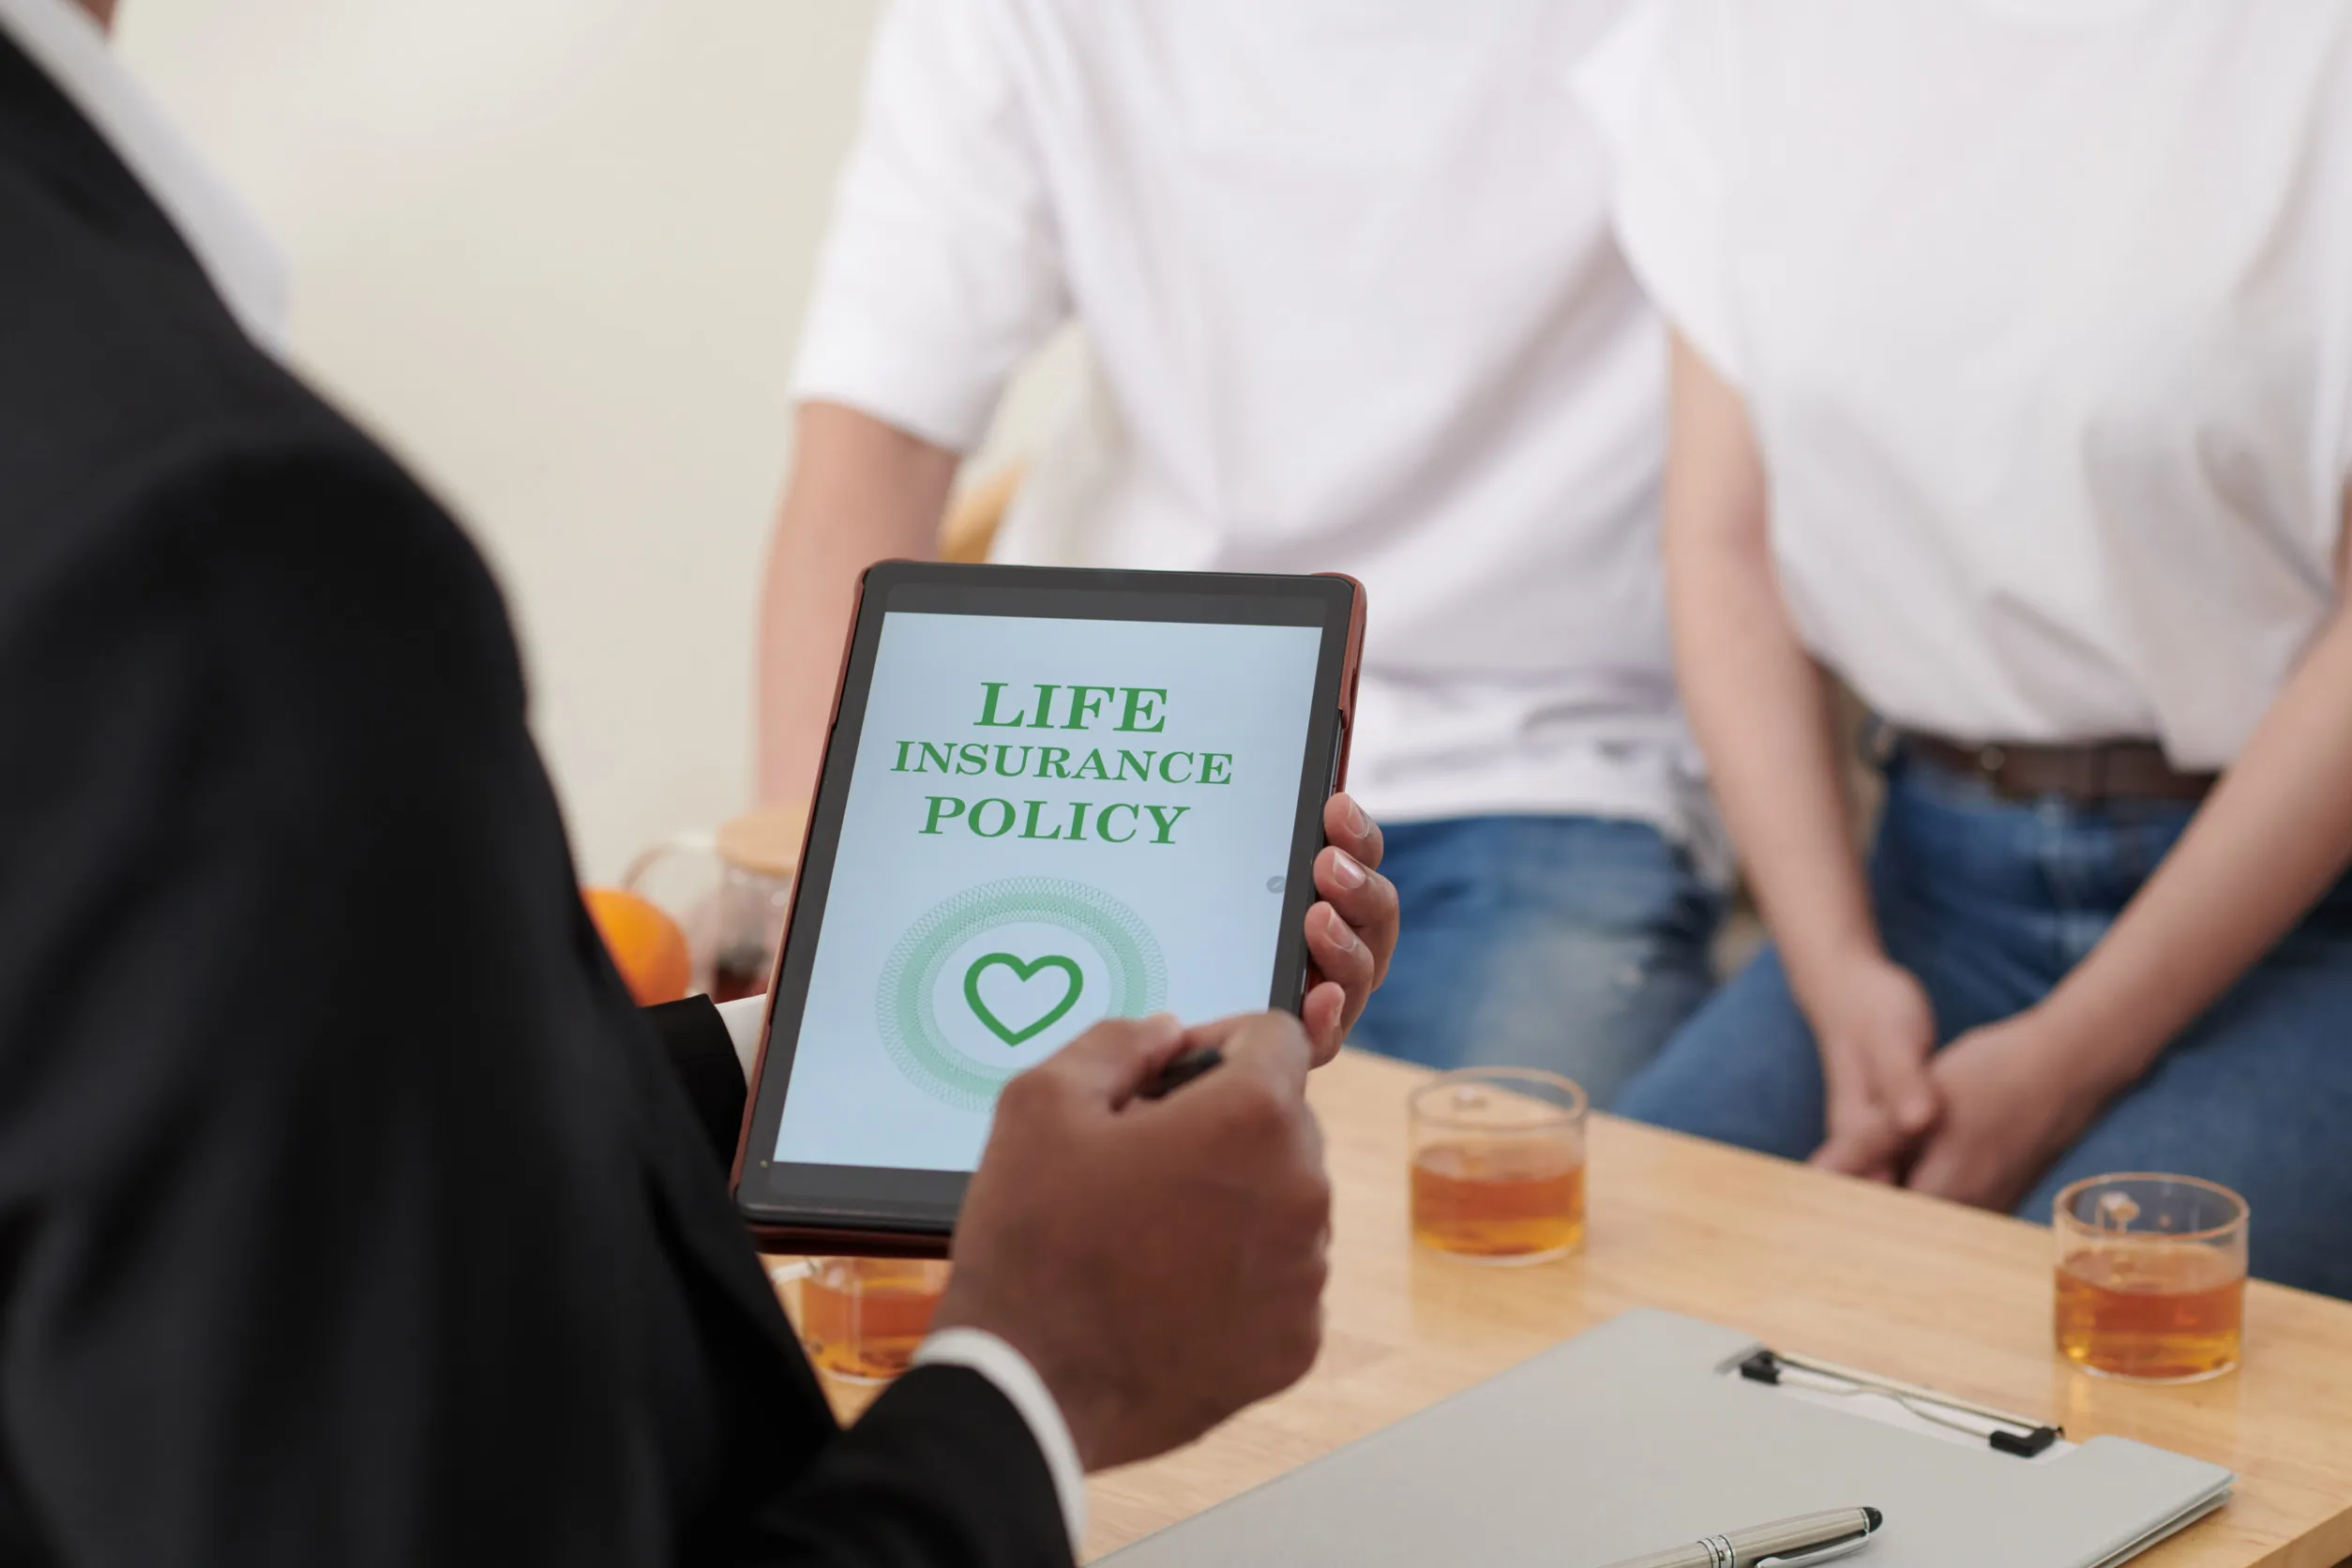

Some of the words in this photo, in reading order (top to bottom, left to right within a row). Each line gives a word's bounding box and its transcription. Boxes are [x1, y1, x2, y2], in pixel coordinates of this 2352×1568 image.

[973, 682, 1168, 732] LIFE
[890, 740, 1233, 785] INSURANCE
[918, 795, 1191, 845] POLICY
